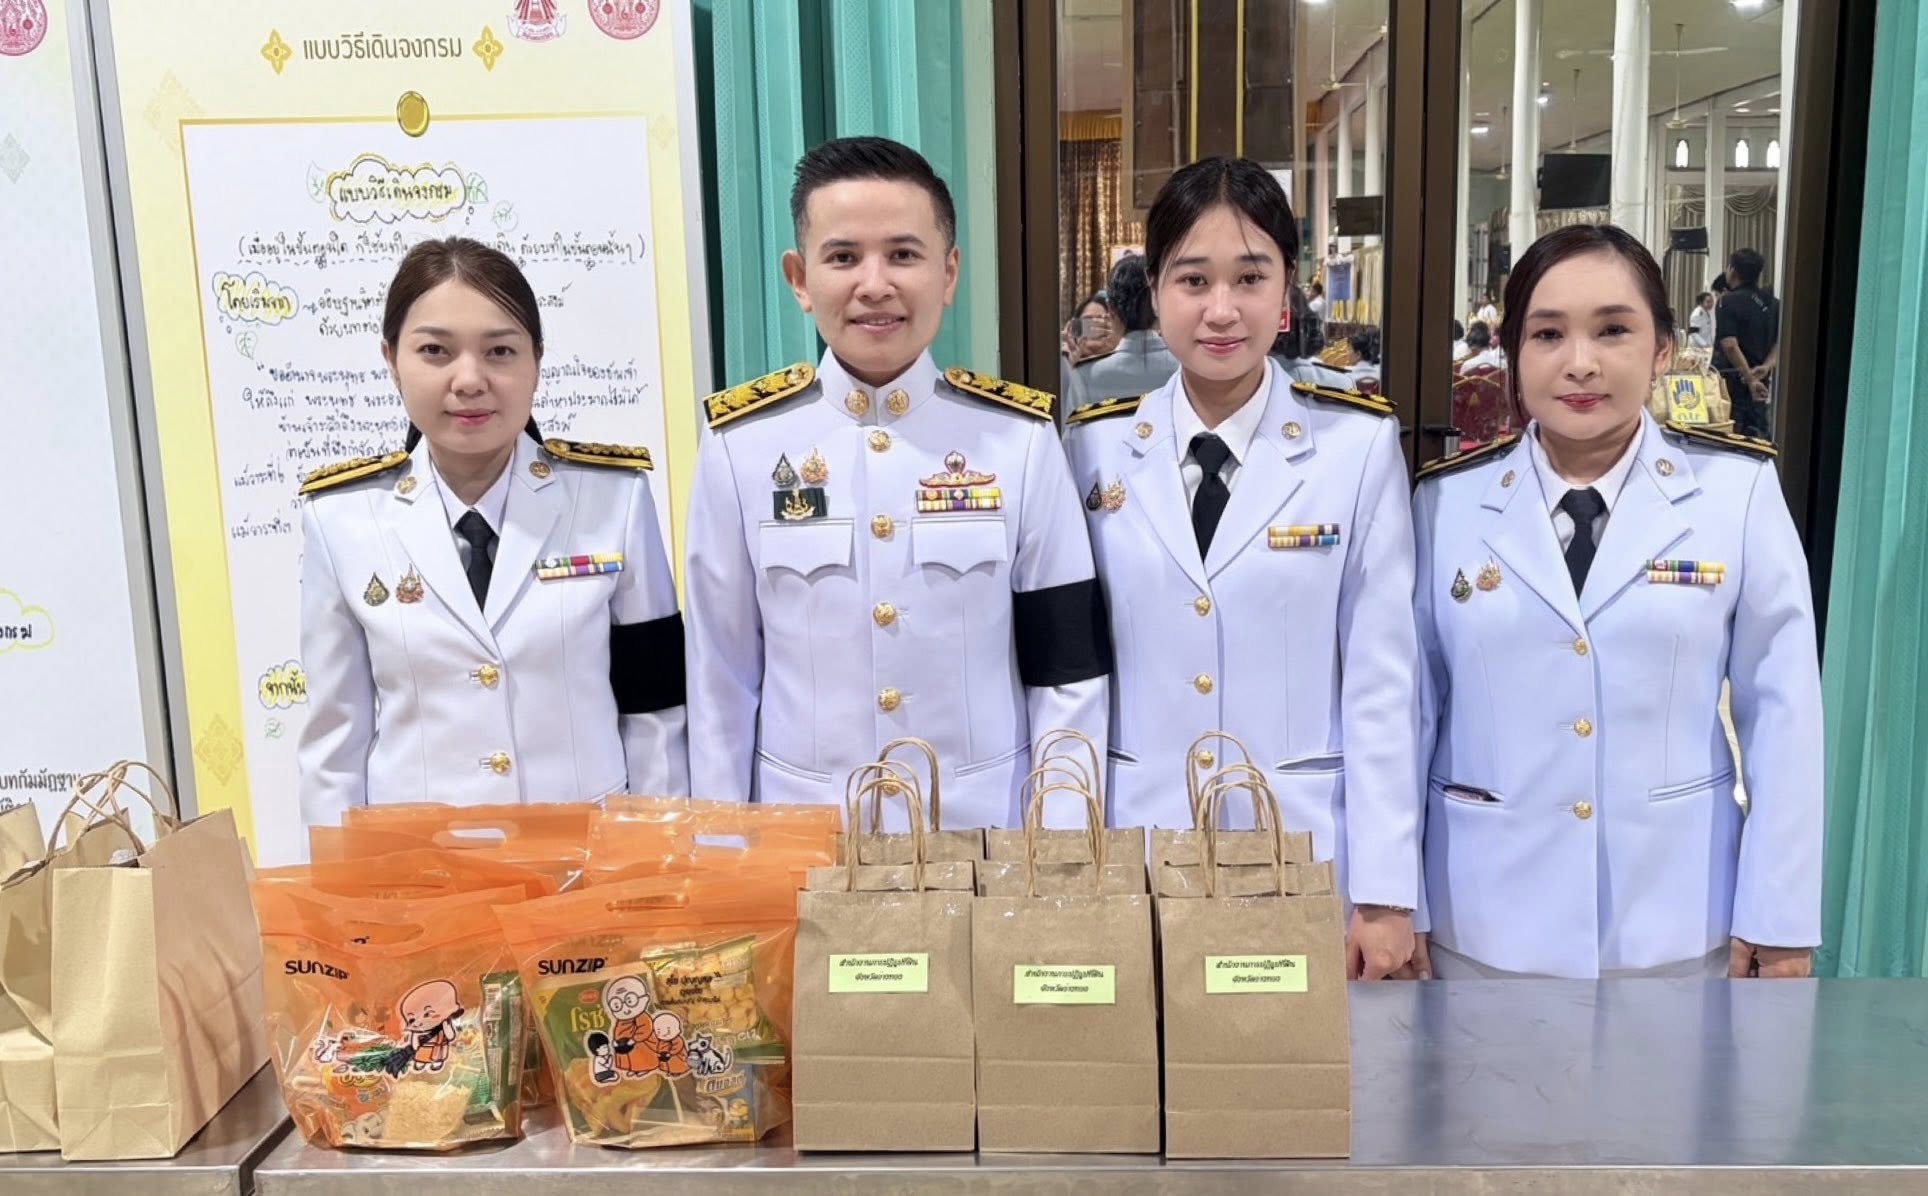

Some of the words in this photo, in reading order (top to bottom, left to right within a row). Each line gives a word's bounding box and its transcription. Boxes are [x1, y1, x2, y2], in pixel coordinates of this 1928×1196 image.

[302, 31, 463, 60] แบบวิธีเดินจงกรม
[339, 174, 452, 203] แบบวิธีเดินจงกรม
[538, 957, 608, 975] SUNZIP
